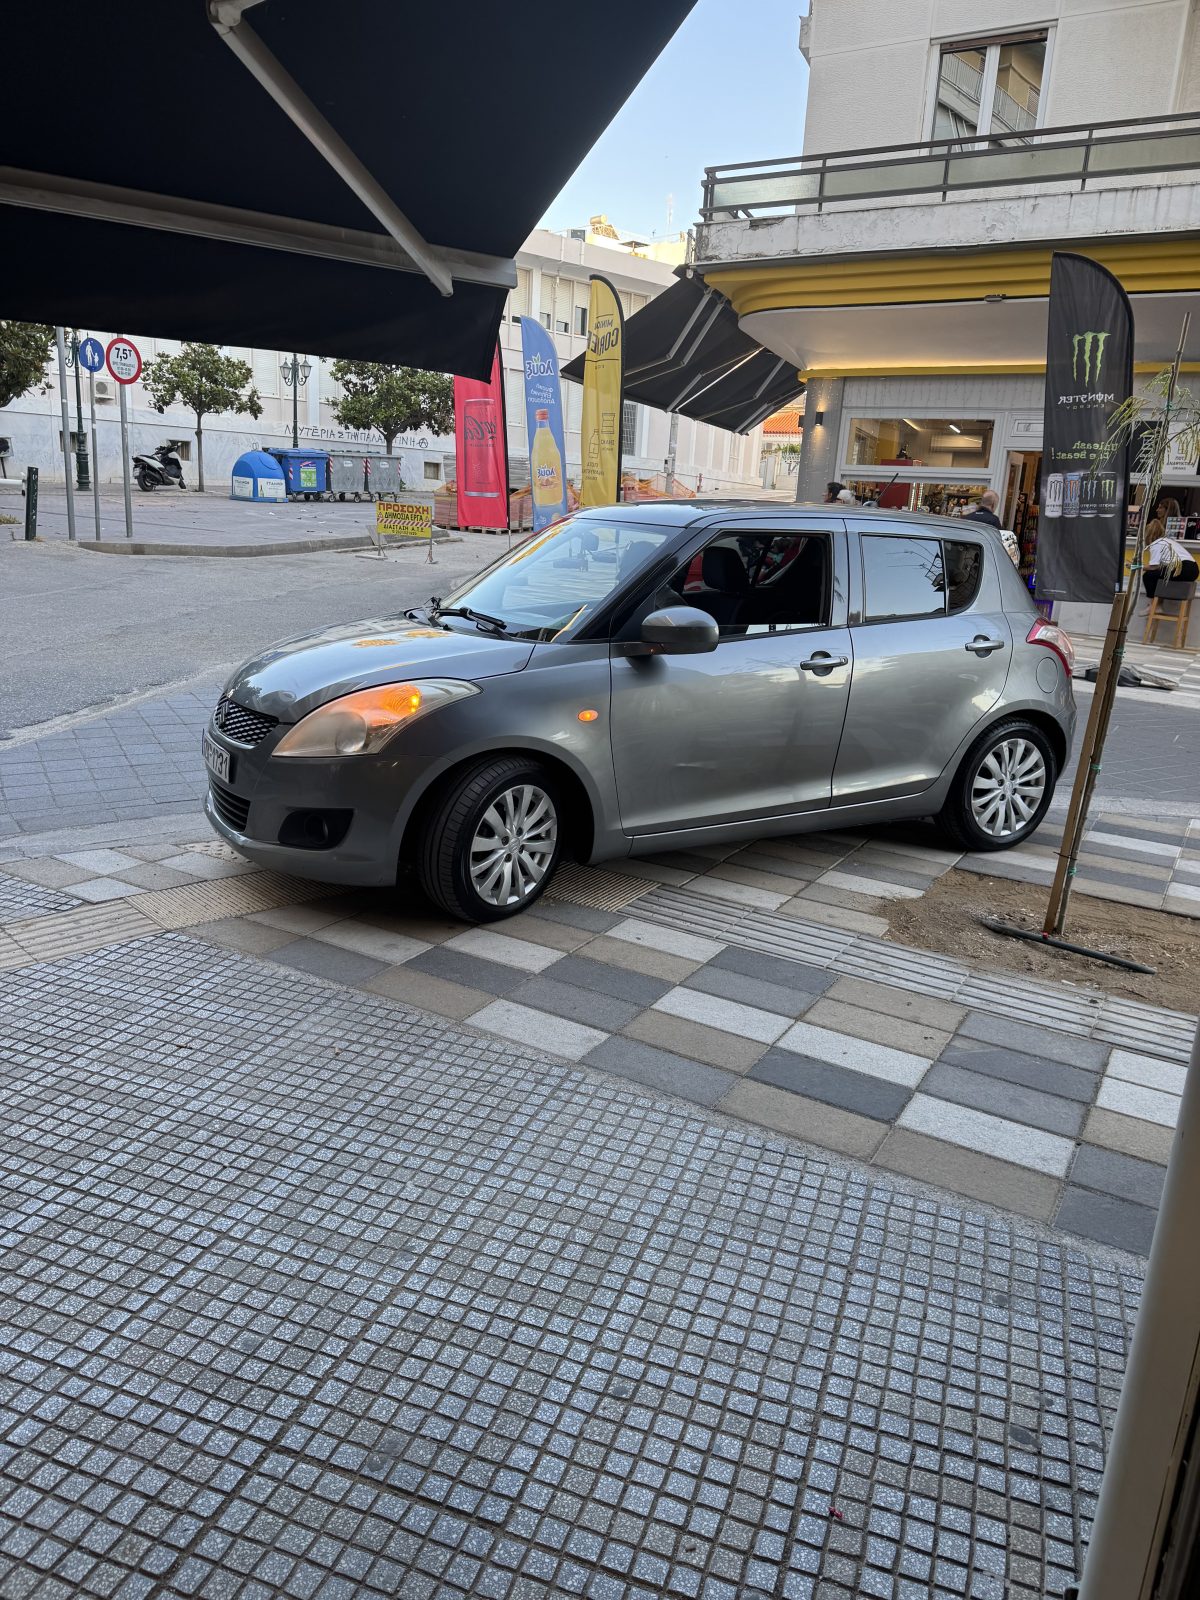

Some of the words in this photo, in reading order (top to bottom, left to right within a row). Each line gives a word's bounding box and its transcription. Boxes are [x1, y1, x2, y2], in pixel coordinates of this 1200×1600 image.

[378, 502, 429, 514] ΠΡΟΣΟΧΗ
[384, 511, 410, 521] ΔΗΜΟΣΙΑ
[410, 514, 424, 522] ΕΡΓΑ
